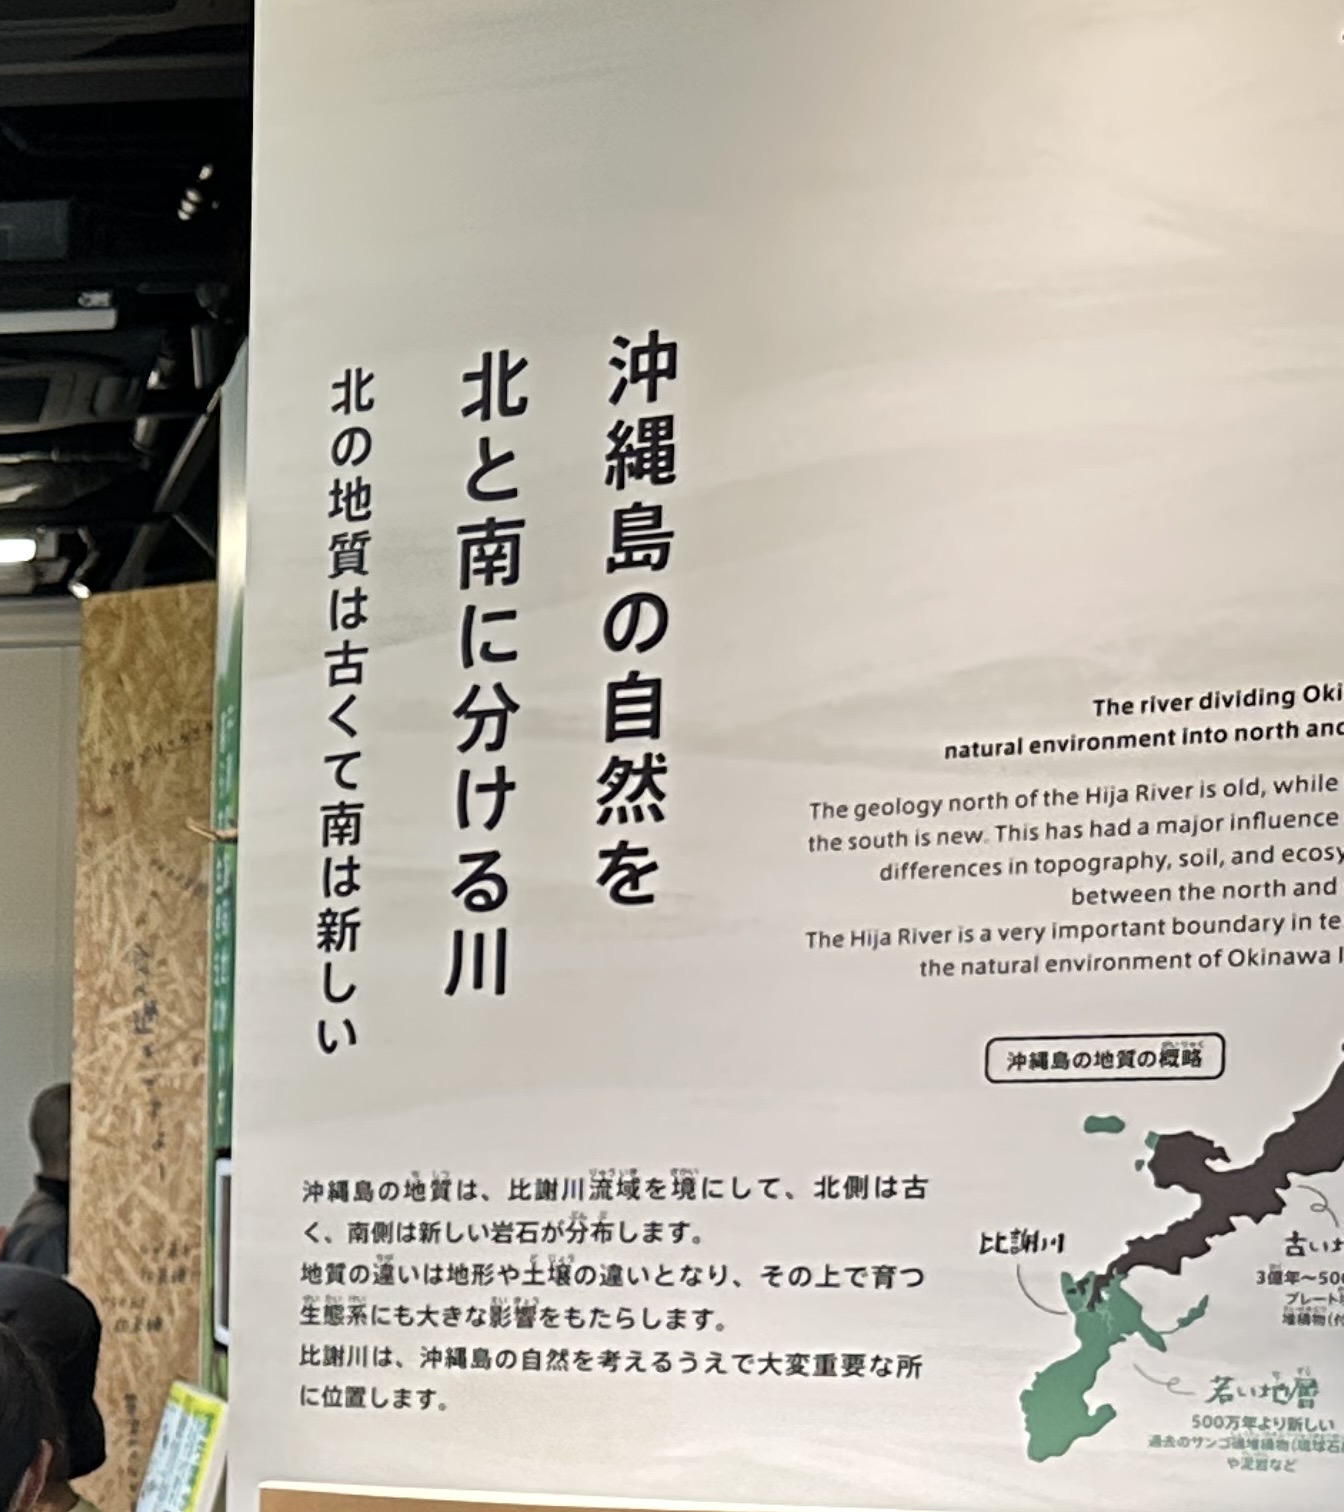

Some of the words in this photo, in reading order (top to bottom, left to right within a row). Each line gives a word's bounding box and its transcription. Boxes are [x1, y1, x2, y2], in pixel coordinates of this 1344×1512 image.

[596, 330, 678, 905] 沖縄島の自然を
[444, 349, 528, 996] 北と南に分ける川
[317, 367, 375, 1054] 北の地質は古くて南は新しい
[1093, 698, 1134, 717] The
[1141, 694, 1191, 714] river
[1198, 688, 1295, 711] dividing
[944, 738, 1023, 760] natural
[1030, 729, 1175, 756] environment
[1182, 727, 1227, 746] into
[1234, 722, 1299, 743] north
[810, 802, 848, 821] The
[854, 797, 943, 822] geology
[949, 791, 1009, 812] north
[1015, 790, 1039, 809] of
[1043, 788, 1079, 807] the
[1086, 785, 1129, 807] Hija
[1137, 782, 1194, 802] River
[1199, 780, 1216, 799] is
[1223, 777, 1266, 800] old,
[1274, 775, 1338, 795] while
[808, 833, 843, 852] the
[848, 829, 907, 851] south
[915, 827, 931, 846] is
[937, 827, 989, 846] new.
[995, 824, 1039, 844] This
[1045, 822, 1083, 840] has
[1089, 818, 1131, 839] had
[1138, 820, 1150, 836] a
[1157, 814, 1224, 838] major
[1230, 809, 1338, 831] influence
[880, 859, 1002, 881] differences
[1009, 856, 1028, 876] in
[1034, 850, 1172, 878] topography,
[1178, 847, 1225, 869] soil,
[1231, 844, 1275, 865] and
[1072, 883, 1171, 906] between
[1178, 883, 1215, 901] the
[1223, 879, 1286, 900] north
[1293, 876, 1337, 898] and
[806, 930, 844, 950] The
[850, 928, 891, 952] Hija
[898, 925, 952, 946] River
[958, 925, 974, 944] is
[980, 927, 992, 942] a
[998, 922, 1045, 945] very
[1052, 916, 1166, 943] important
[1172, 912, 1285, 938] boundary
[1291, 913, 1311, 932] in
[920, 959, 955, 977] the
[961, 954, 1039, 975] natural
[1046, 950, 1191, 973] environment
[1199, 949, 1222, 968] of
[1227, 946, 1331, 968] Okinawa
[1007, 1049, 1203, 1071] 沖縄島の地質の概略
[301, 1174, 929, 1203] 沖縄島の地質は、比謝川流域を境にして、北側は古
[302, 1220, 705, 1246] く、南側は新しい岩石が分布します。
[978, 1228, 1064, 1256] 比謝川
[300, 1262, 925, 1290] 地質の違いは地形や土壌の違いとなり、その上で育つ
[300, 1304, 725, 1332] 生態系にも大きな影響をもたらします。
[299, 1344, 923, 1379] 比謝川は、沖縄島の自然を考えるうえで大変重要な所
[299, 1385, 447, 1413] に位置します。
[1205, 1375, 1319, 1410] 若い地層
[1192, 1414, 1335, 1433] 500万年より新しい
